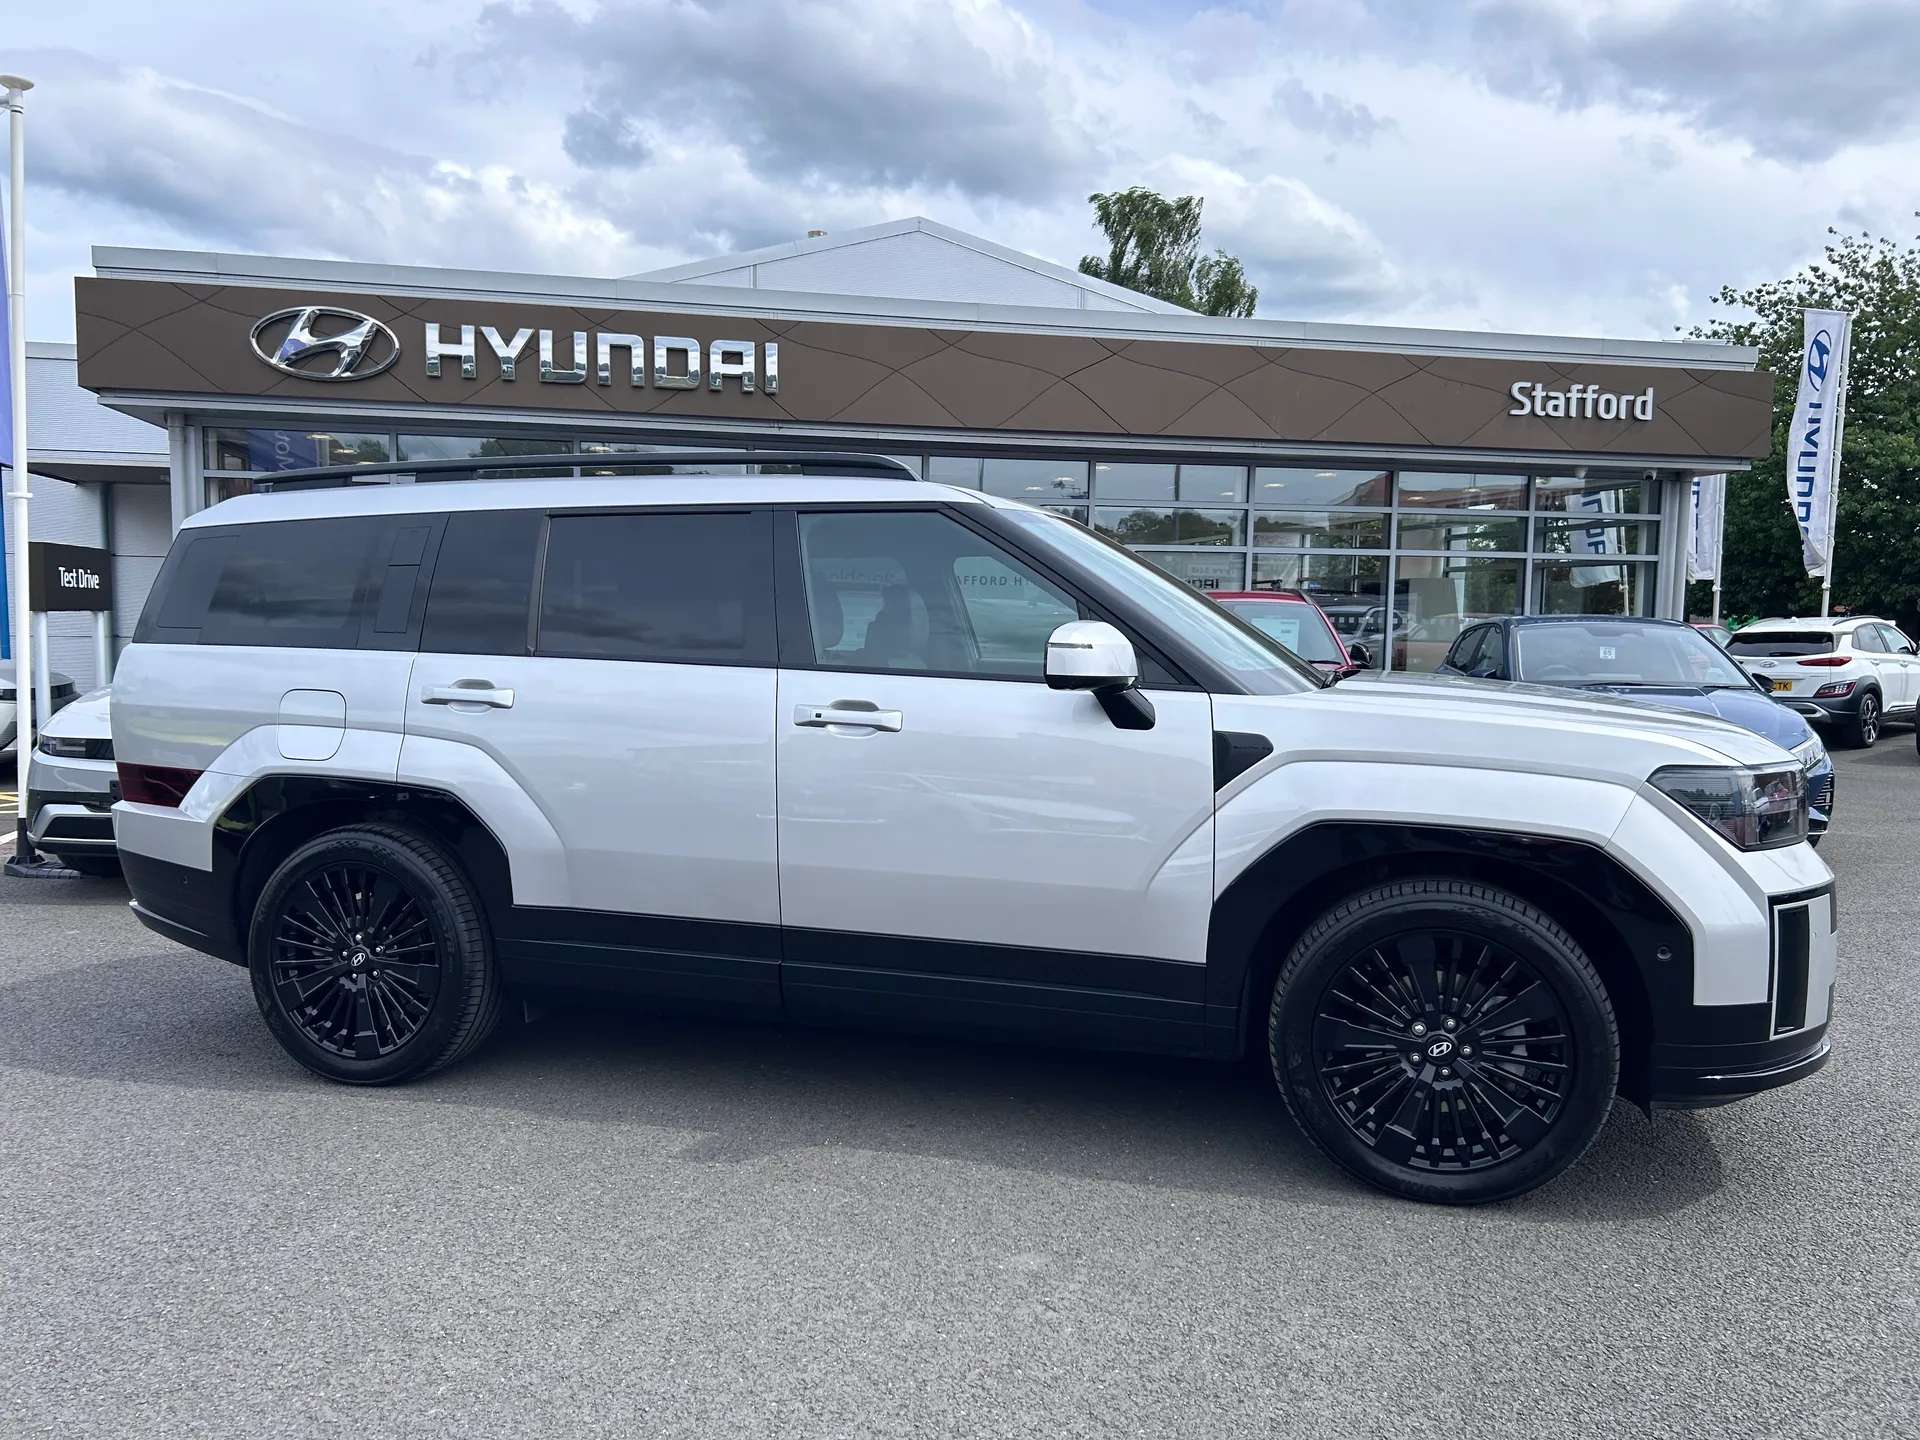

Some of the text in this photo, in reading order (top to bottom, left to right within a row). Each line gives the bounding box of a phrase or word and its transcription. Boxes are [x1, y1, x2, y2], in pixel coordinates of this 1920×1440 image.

[425, 323, 780, 395] HYUNDAI
[1509, 382, 1654, 421] Stafford
[1796, 402, 1823, 538] HYUND
[58, 566, 100, 589] Test Drive
